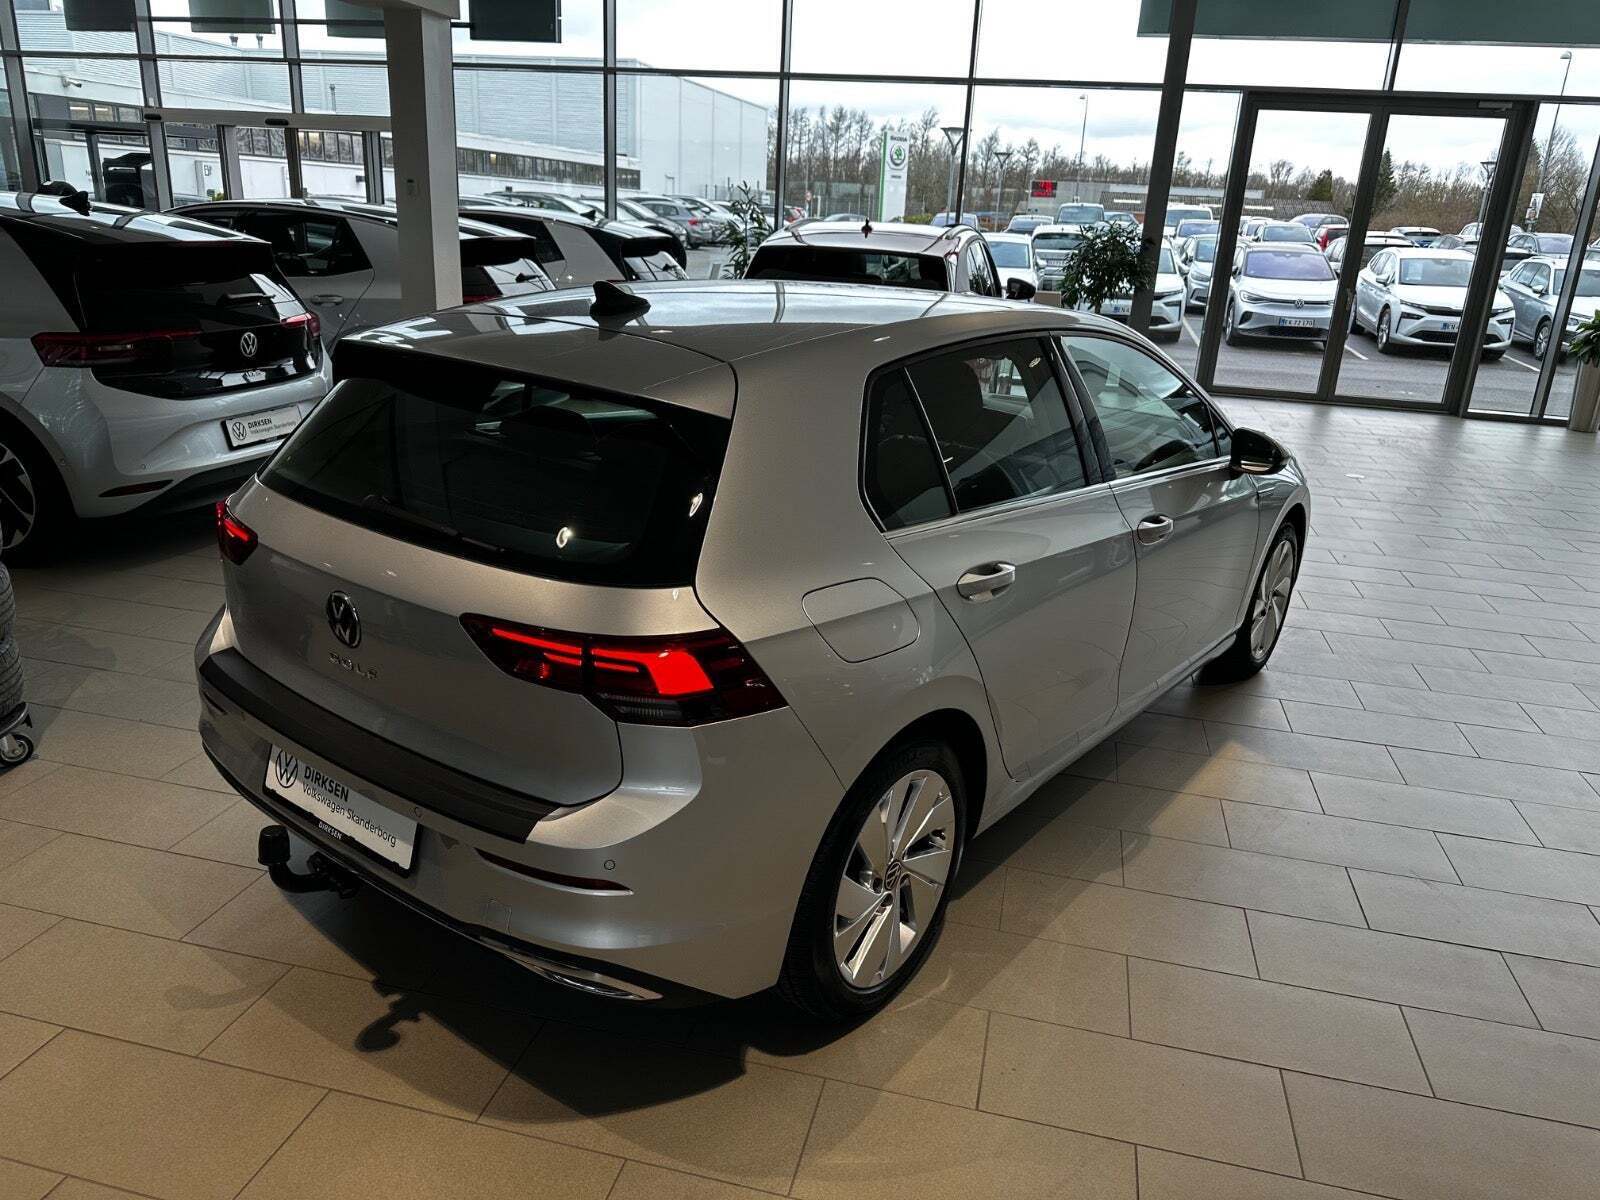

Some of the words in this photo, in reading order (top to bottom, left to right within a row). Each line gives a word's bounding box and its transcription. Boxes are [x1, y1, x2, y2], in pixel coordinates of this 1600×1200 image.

[248, 418, 272, 429] DIRKSEN
[304, 765, 349, 802] DIRKSEN
[302, 782, 345, 816] Volkswagen
[347, 808, 397, 847] Skanderborg
[318, 821, 343, 841] DIRKSEN
